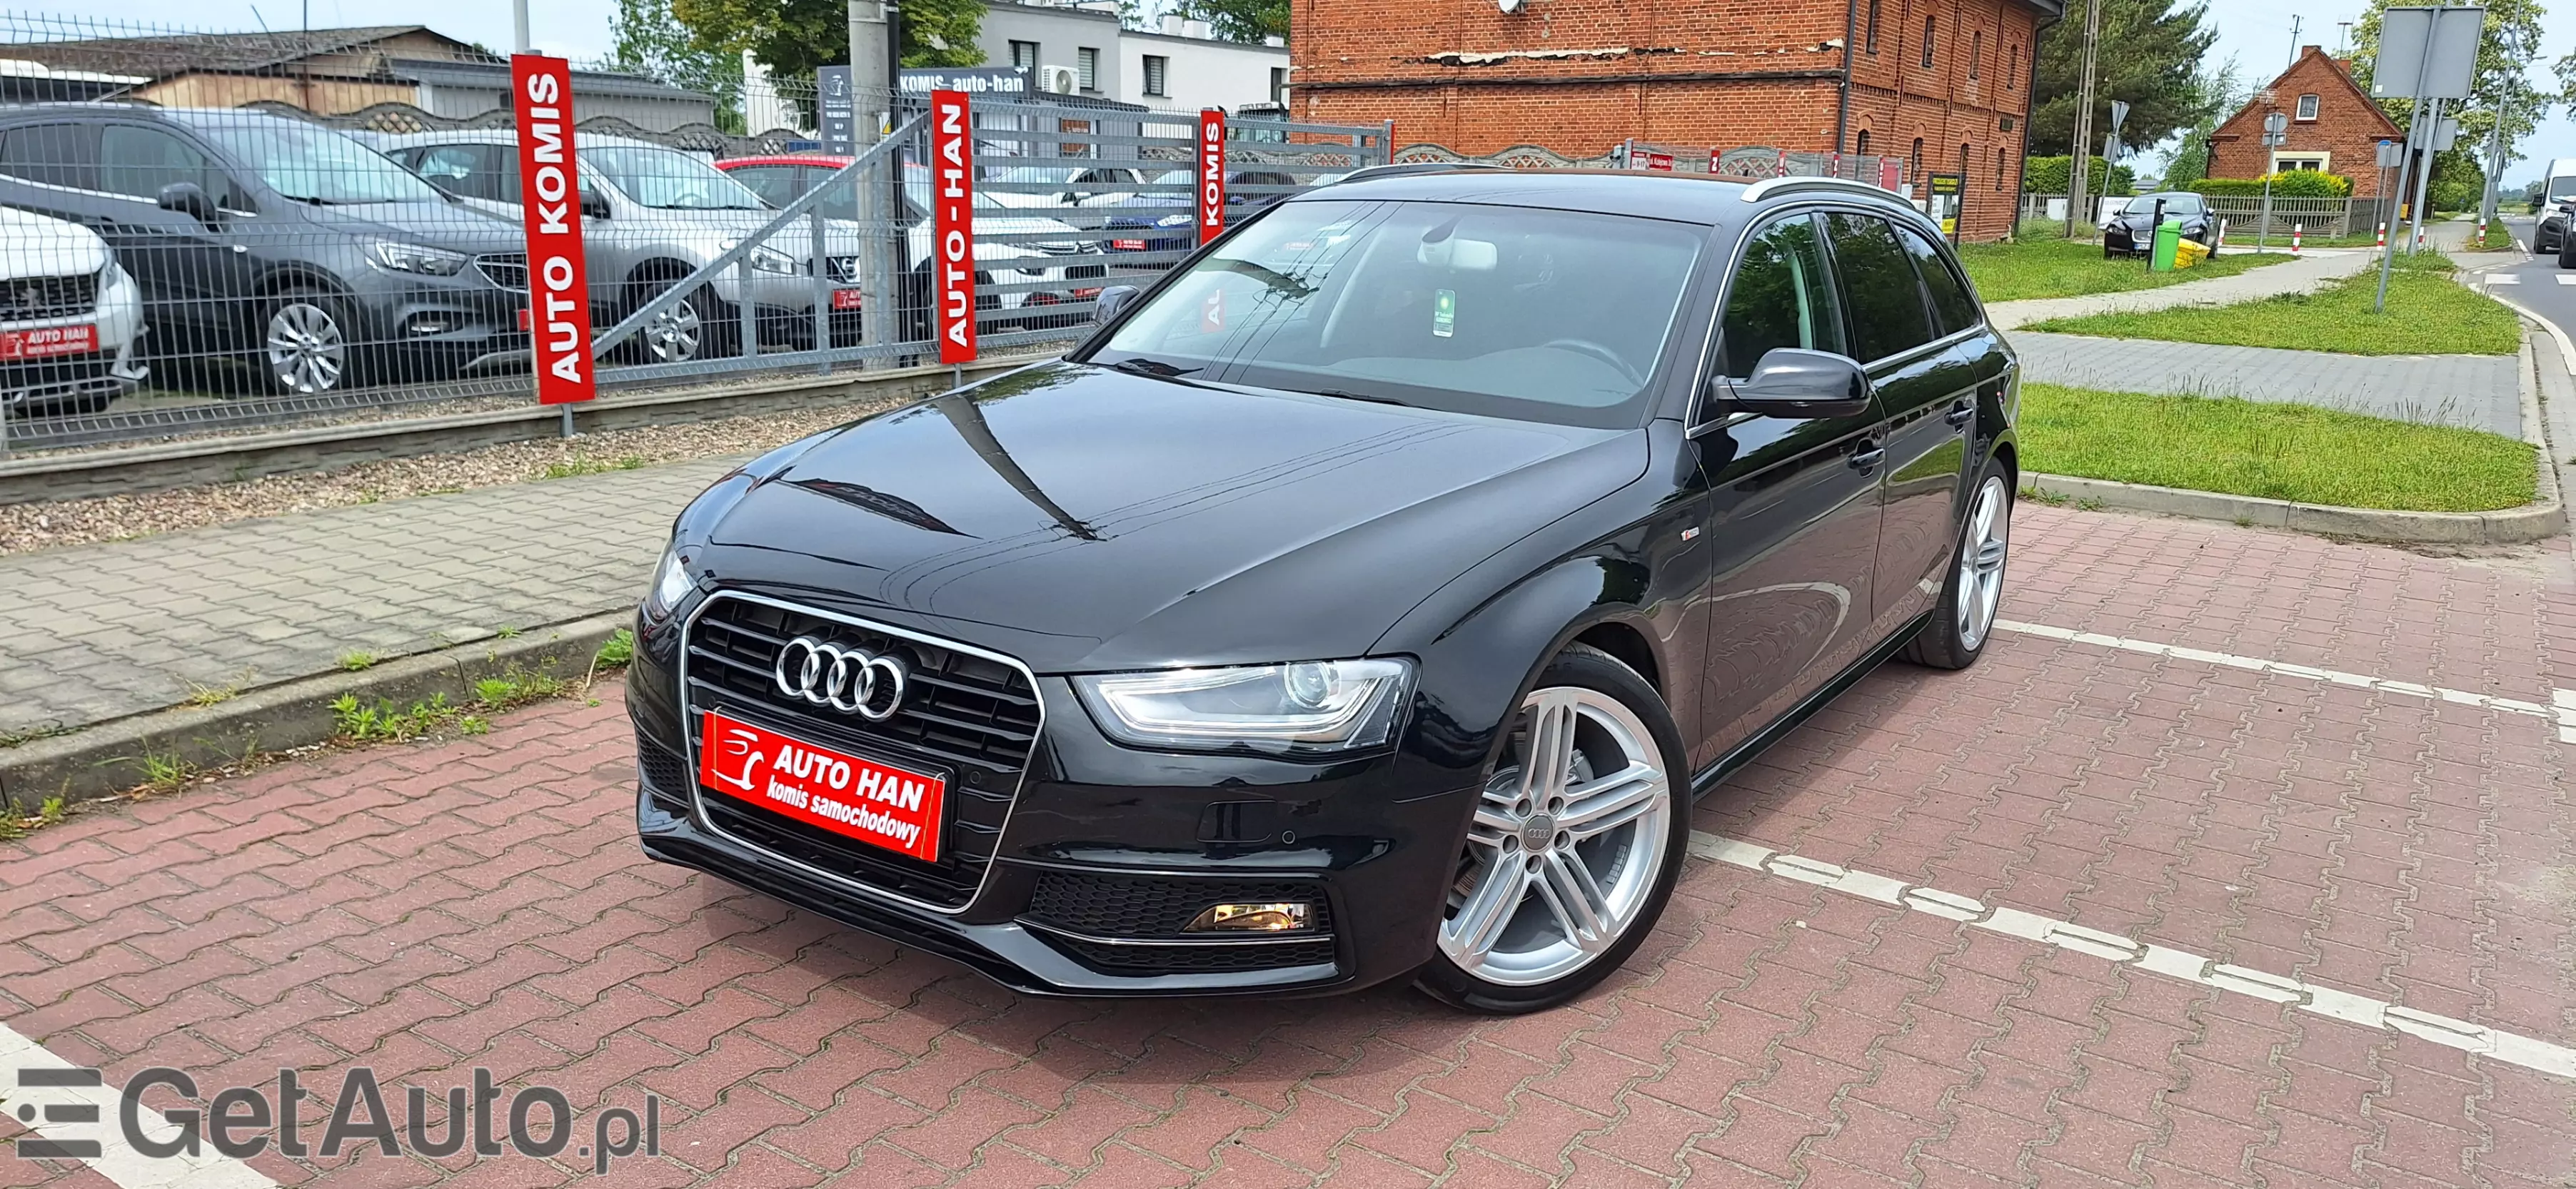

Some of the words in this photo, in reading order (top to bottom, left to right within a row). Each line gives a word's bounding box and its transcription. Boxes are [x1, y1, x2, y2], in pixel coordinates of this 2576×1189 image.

[900, 75, 944, 92] KOMIS
[952, 75, 1024, 92] auto-han
[528, 73, 570, 234] KOMIS
[1205, 122, 1219, 226] KOMIS
[28, 330, 62, 343] AUTO
[543, 255, 581, 383] AUTO
[766, 774, 809, 809] komis
[810, 795, 921, 849] samochodowy
[773, 744, 851, 790] AUTO
[855, 768, 925, 811] HAN
